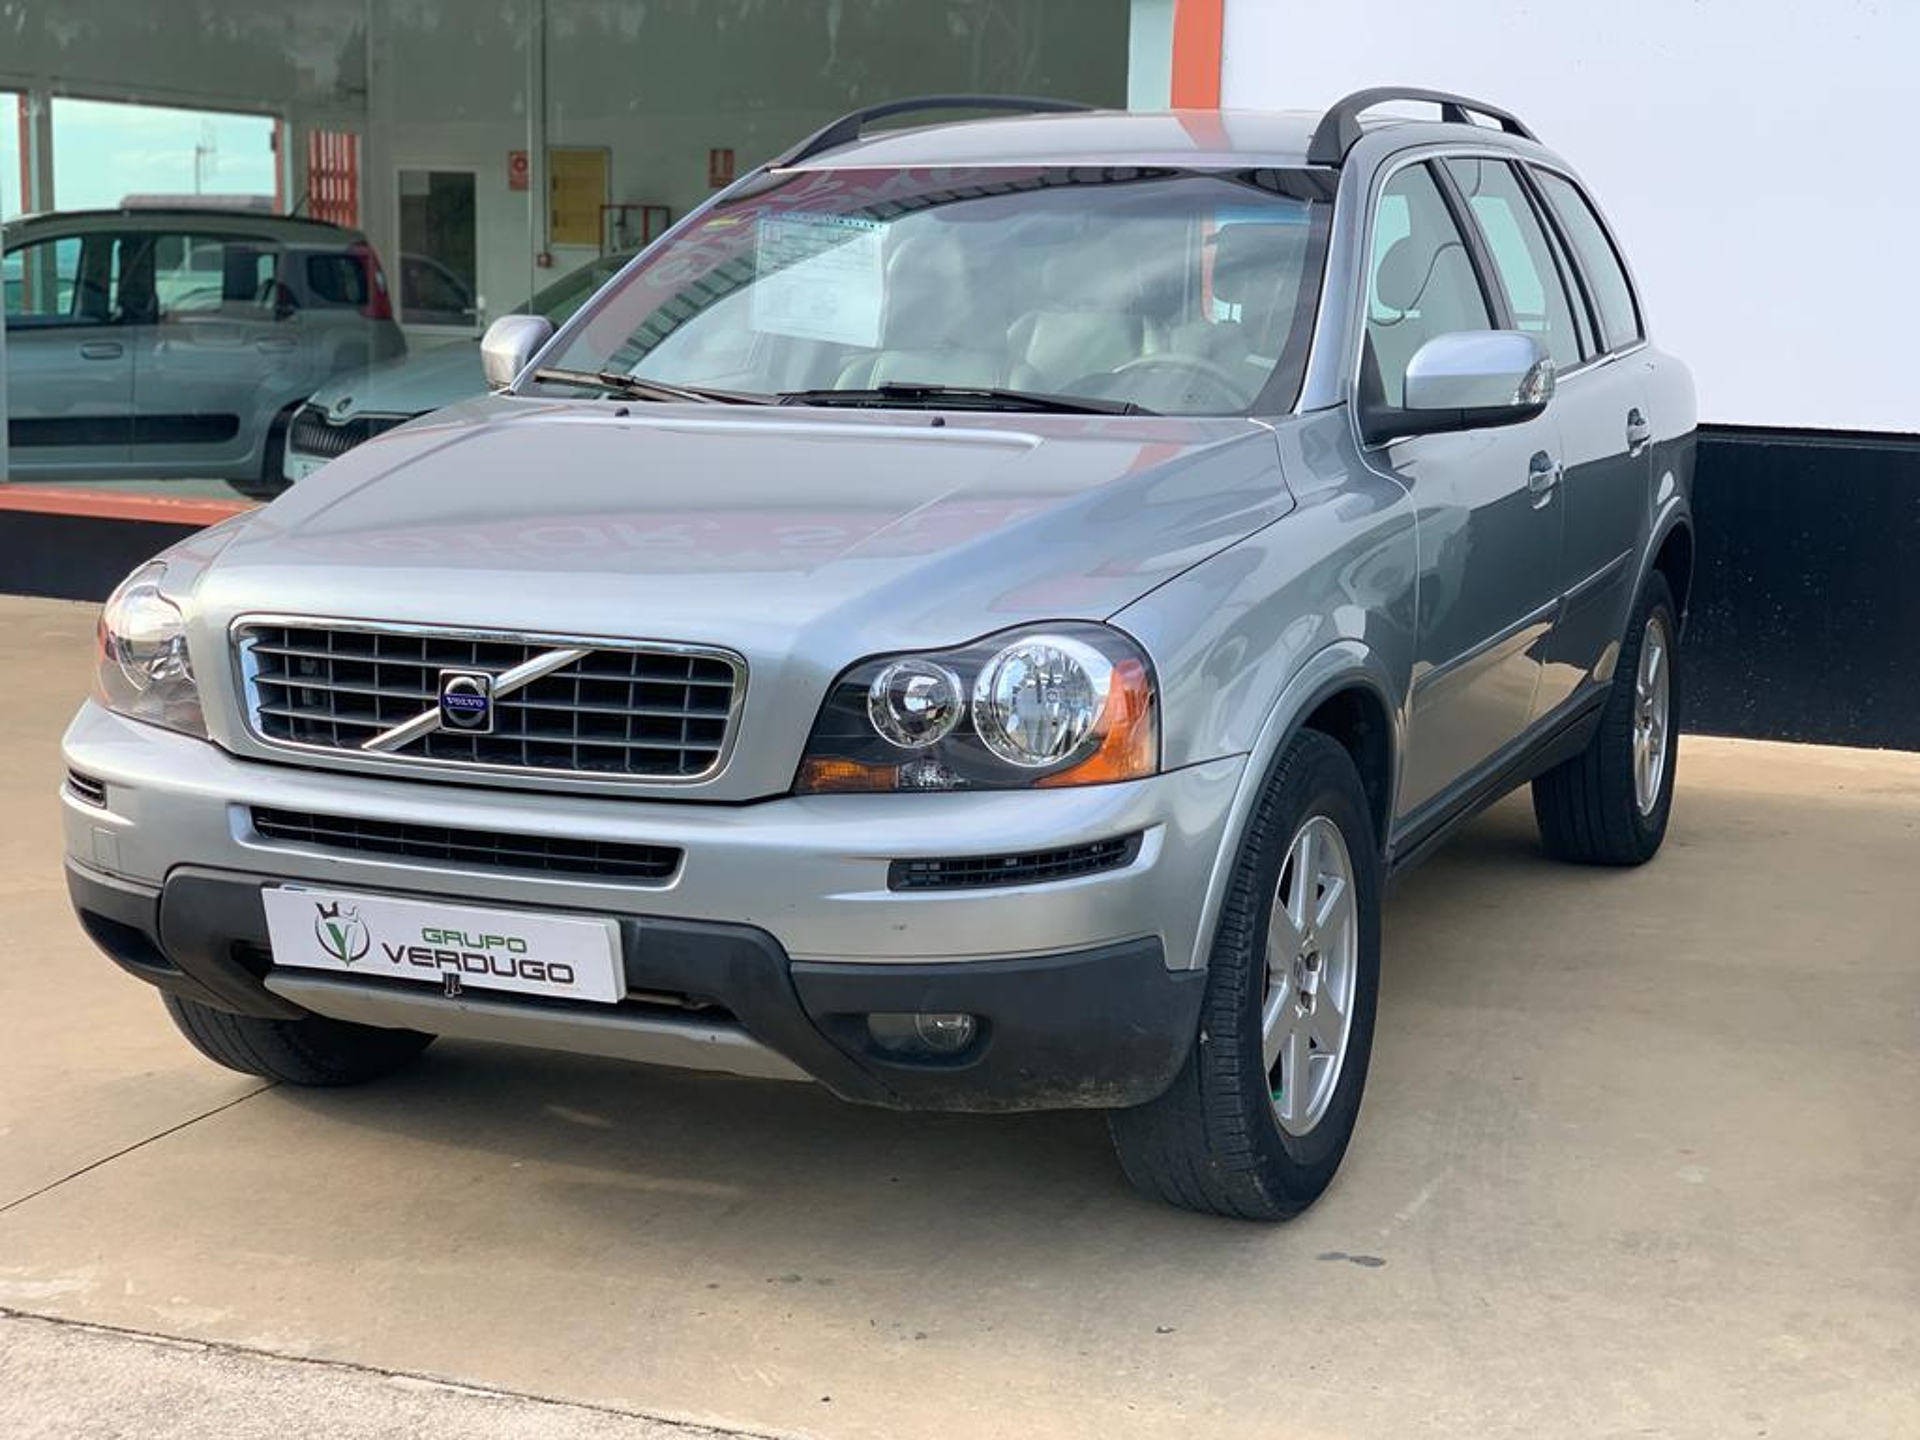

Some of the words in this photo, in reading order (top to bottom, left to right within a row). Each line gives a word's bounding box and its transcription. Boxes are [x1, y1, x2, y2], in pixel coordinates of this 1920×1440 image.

[446, 697, 485, 708] VOLVO
[421, 927, 527, 953] GRUPO
[381, 942, 575, 984] VERDUGO
